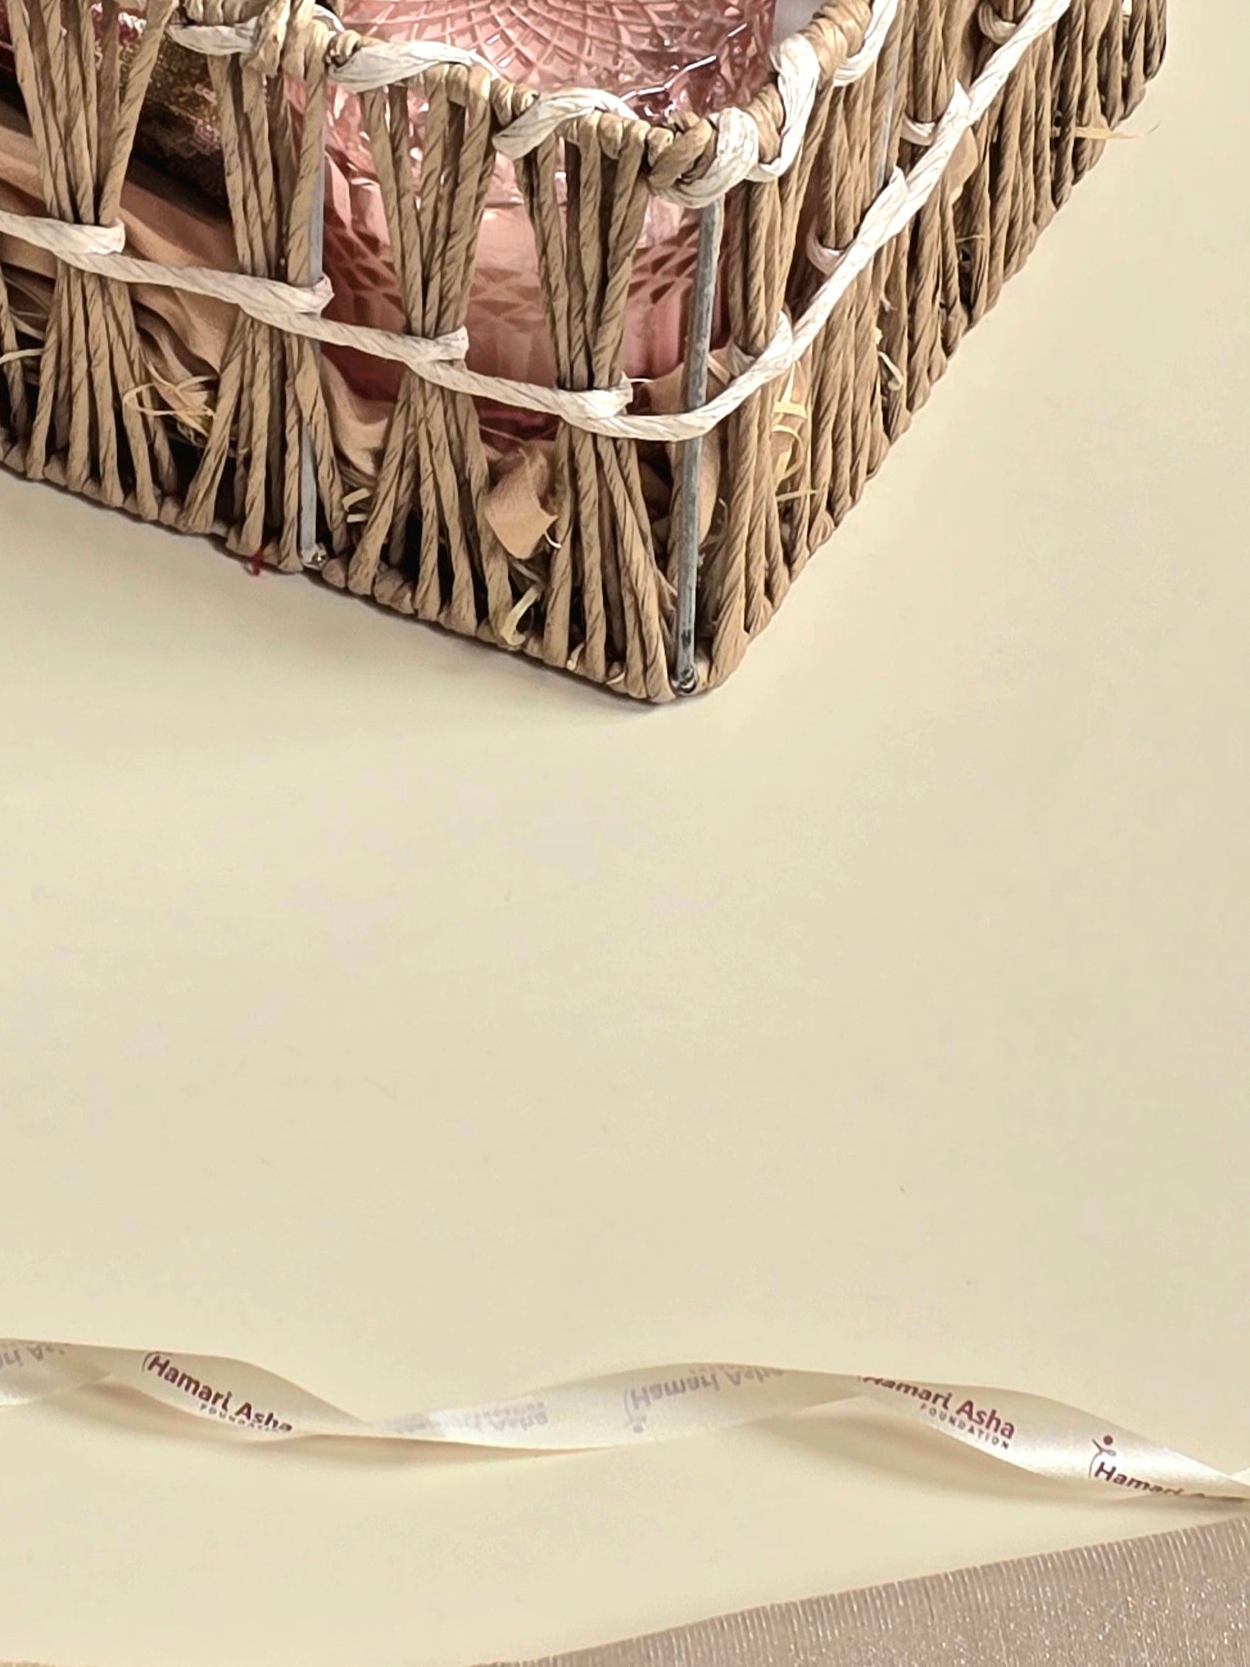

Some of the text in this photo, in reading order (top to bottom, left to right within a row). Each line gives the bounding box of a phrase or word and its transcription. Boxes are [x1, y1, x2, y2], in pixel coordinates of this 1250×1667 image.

[147, 1353, 293, 1432] Hamari Asha
[920, 1403, 1010, 1450] FOUNDATION
[955, 1399, 1016, 1440] Asha
